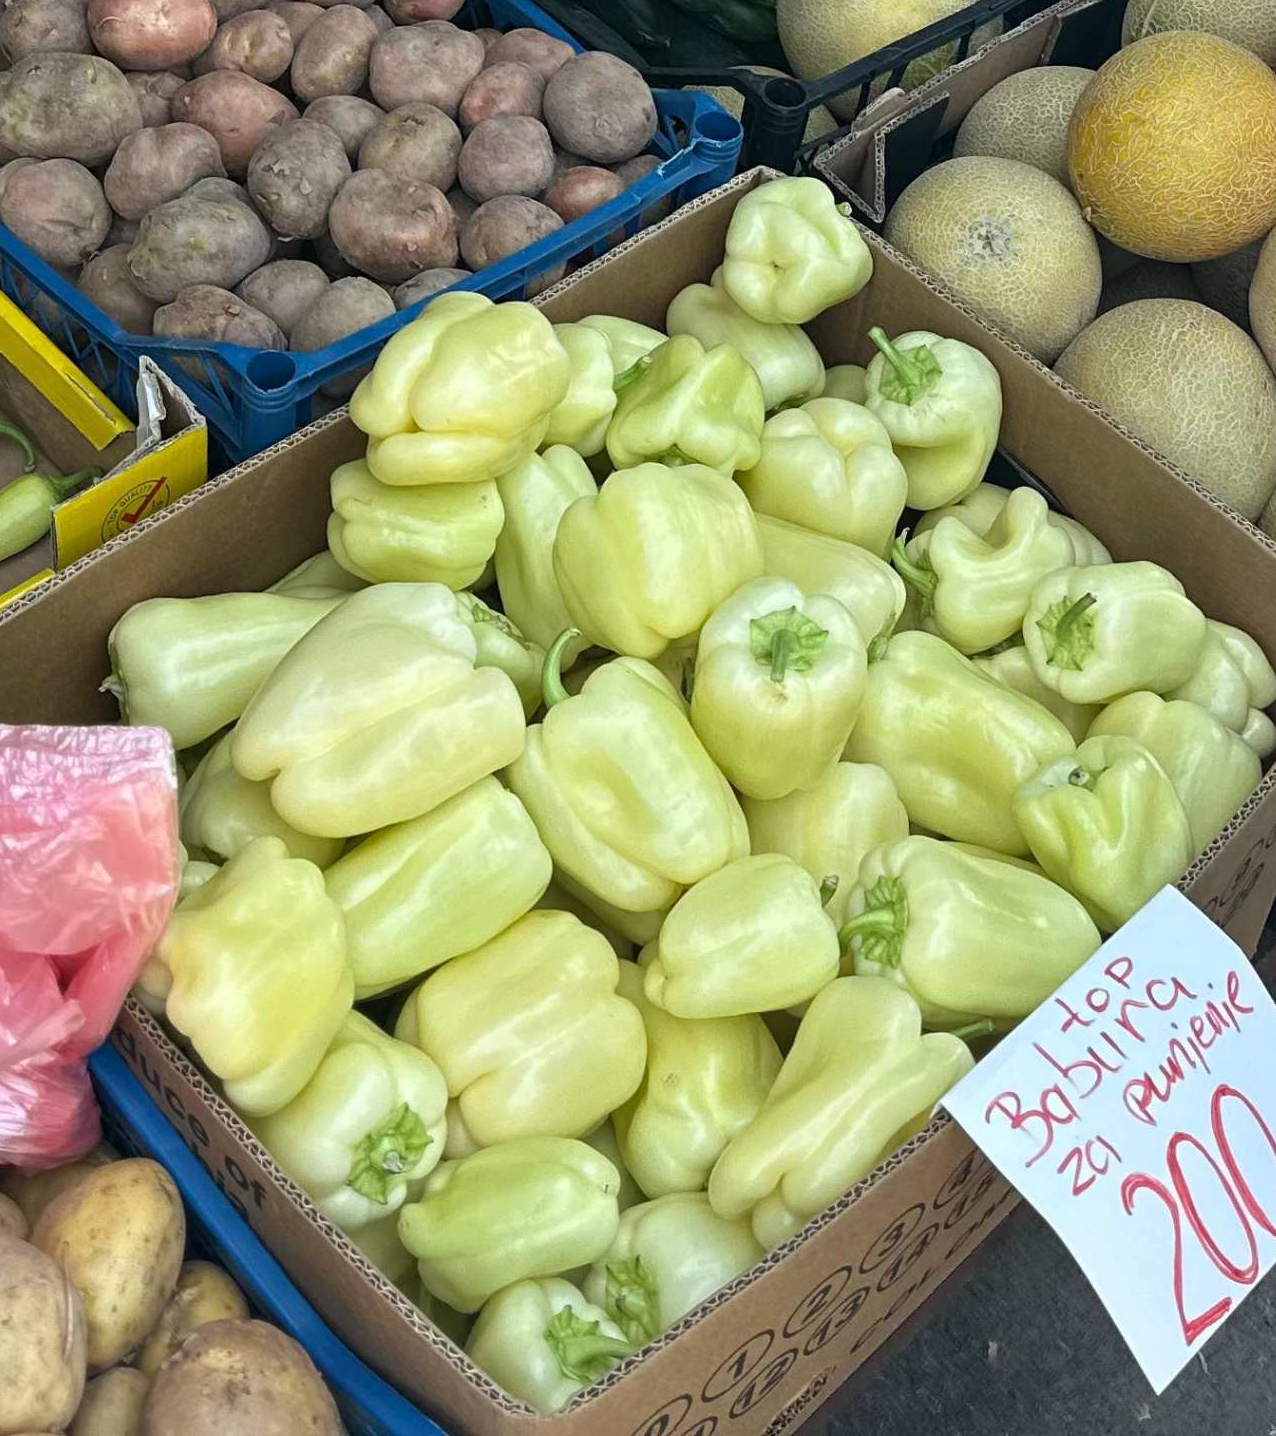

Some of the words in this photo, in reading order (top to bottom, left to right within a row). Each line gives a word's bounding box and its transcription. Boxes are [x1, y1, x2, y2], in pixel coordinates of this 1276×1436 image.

[226, 1155, 266, 1209] of
[1057, 1135, 1122, 1196] za
[727, 1350, 748, 1379] 1
[802, 1286, 831, 1323] 2
[879, 1222, 905, 1257] 3
[736, 1357, 790, 1410] 12
[818, 1297, 862, 1344] 13
